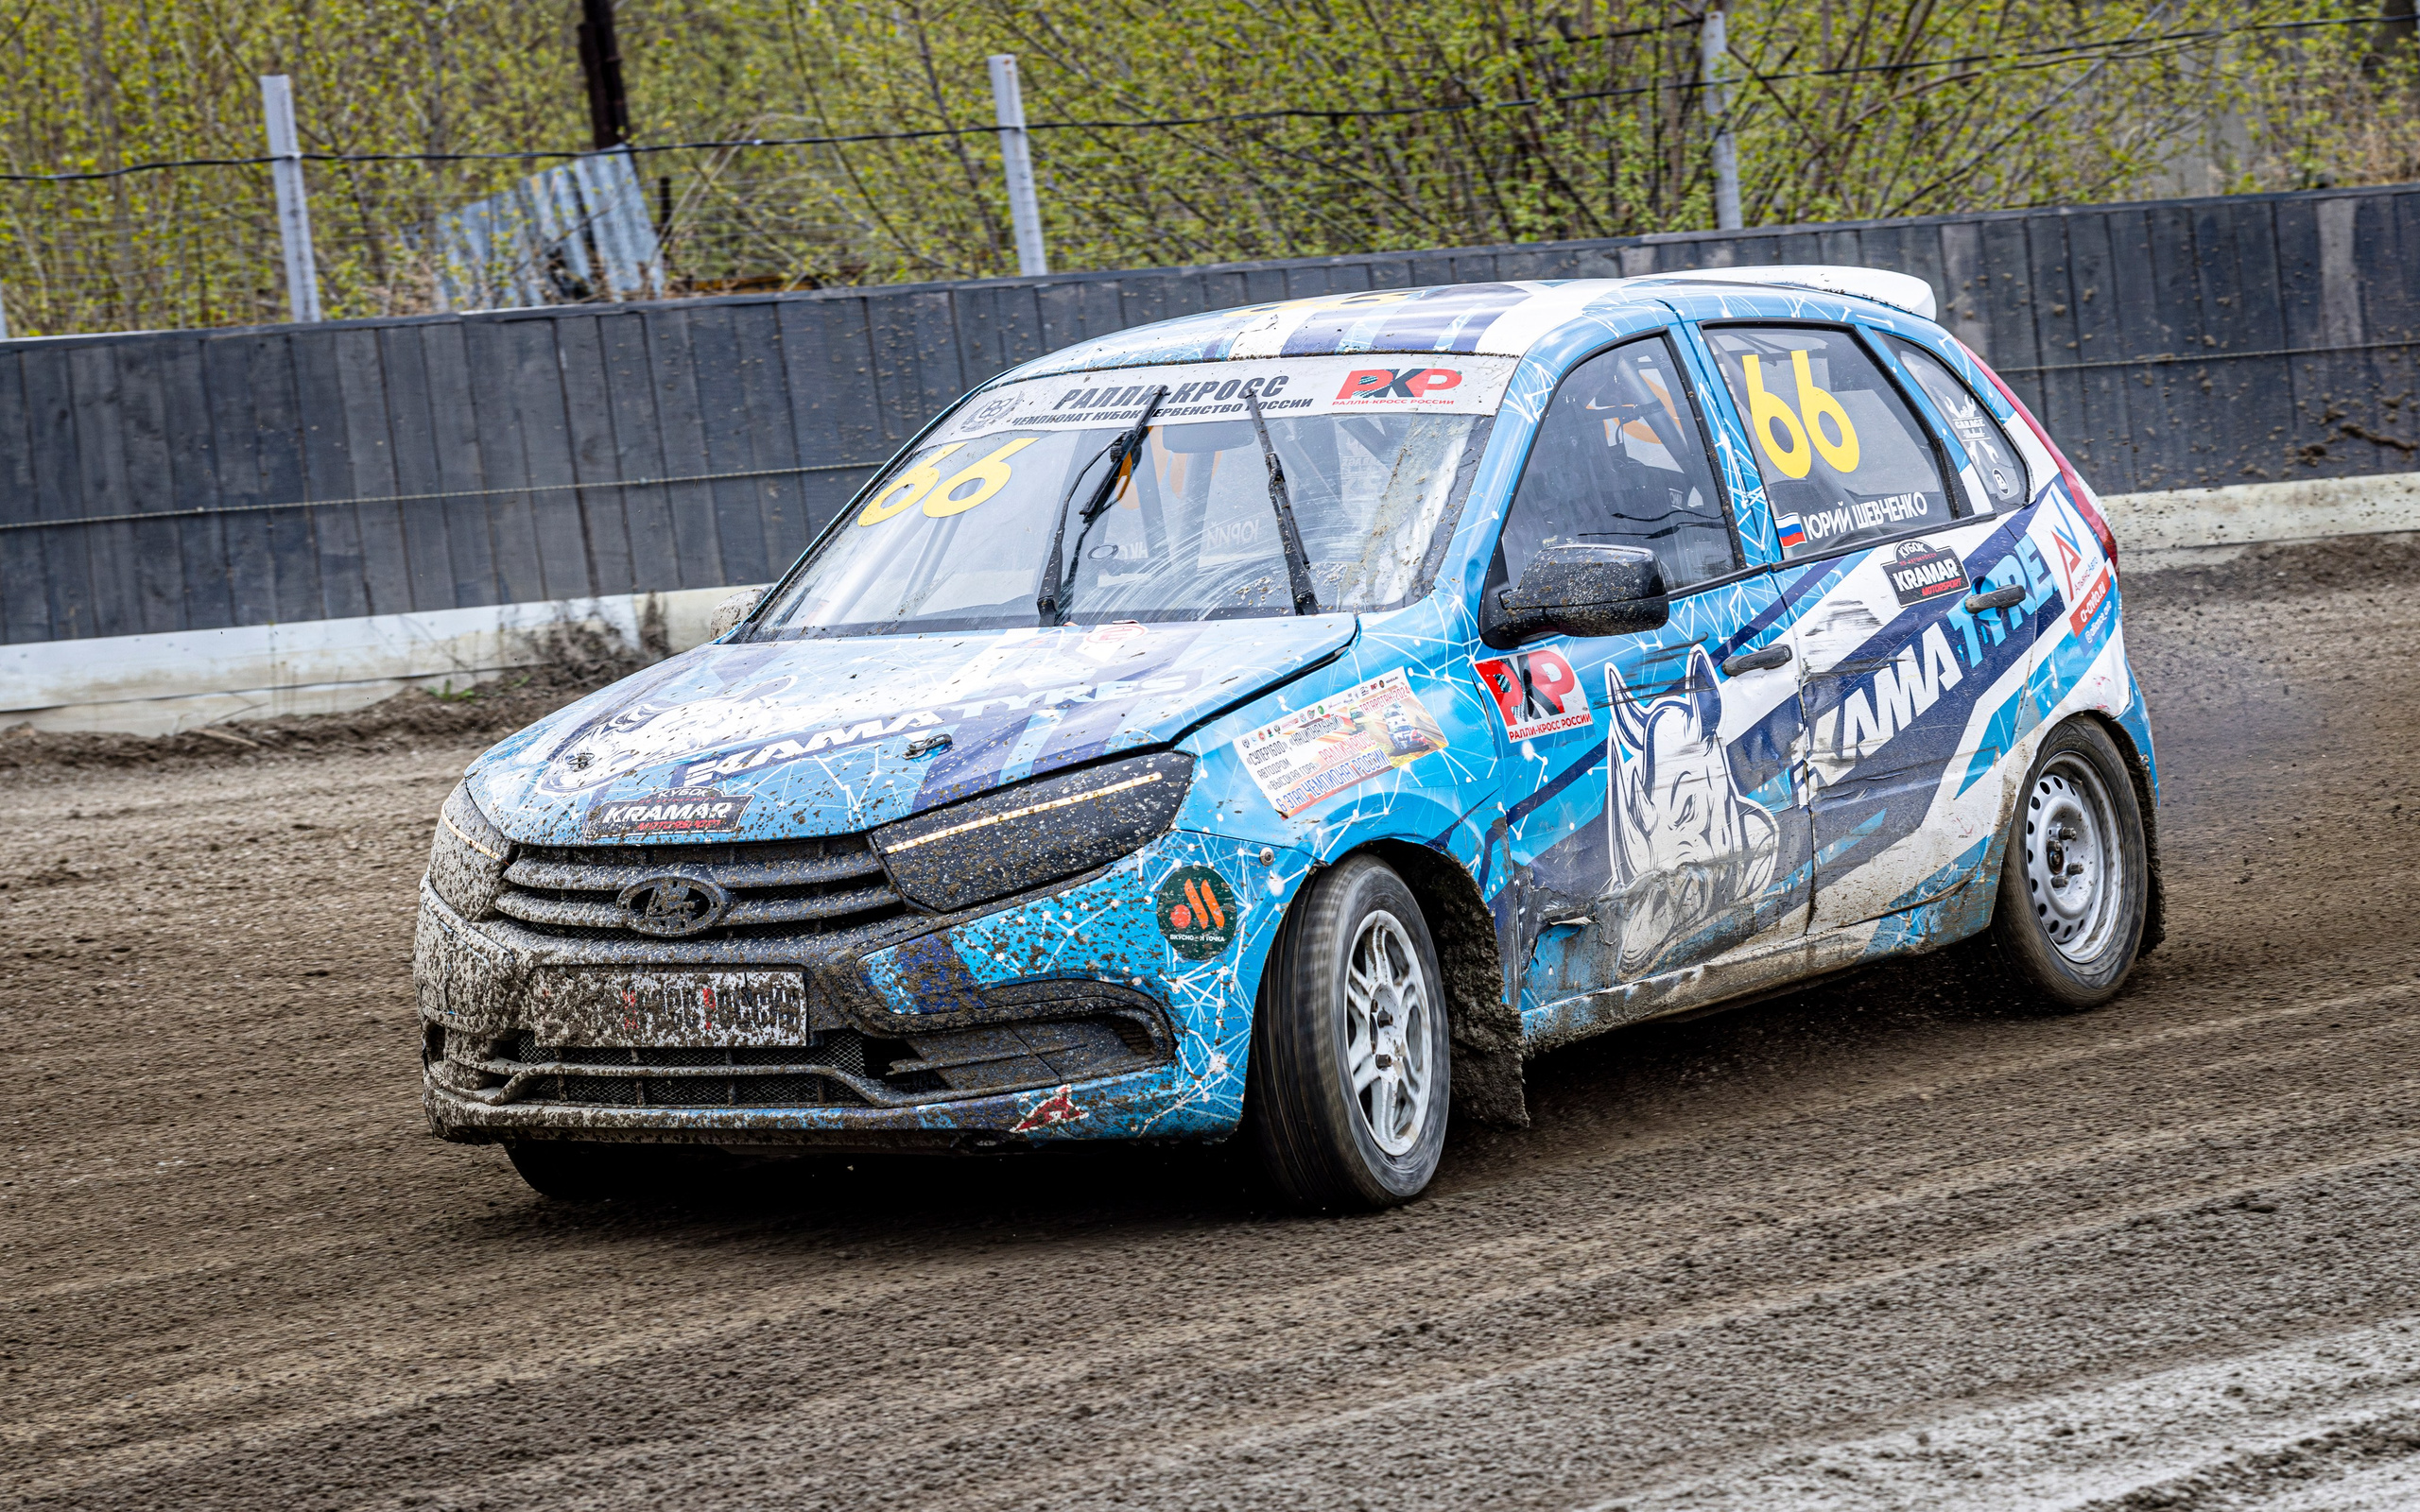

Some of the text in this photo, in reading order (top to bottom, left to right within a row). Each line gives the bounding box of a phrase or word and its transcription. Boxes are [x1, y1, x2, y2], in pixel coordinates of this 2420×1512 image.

[1011, 412, 1095, 426] ЧЕМПИОНАТ
[1092, 409, 1143, 421] КУБОК
[1244, 398, 1314, 412] ОССИИ
[1741, 349, 1860, 479] 66
[857, 437, 1040, 527] 66
[1802, 491, 1928, 541] ЮРИЙ ШЕВЧЕНКО
[1898, 542, 1928, 558] КУБОК
[1893, 558, 1961, 593] KRAMAR
[1921, 577, 1962, 596] MOTORSPORT
[1509, 713, 1592, 740] РАЛЛИ-КРОСС РОССИИ
[1789, 621, 1963, 810] KAMA
[683, 675, 1187, 787] KAMA TYRES
[1318, 730, 1377, 765] РАЛЛИ-КРОСС
[1256, 758, 1292, 781] АВТОДРОМ
[1267, 761, 1322, 791] «ВЫСОКАЯ ГОРА»
[1275, 748, 1392, 813] 6 ЭТАП ЧЕМПИОНАТ РОССИИ
[657, 787, 710, 799] КУБОК
[602, 802, 733, 824] KRAMAR
[637, 819, 722, 832] MOTORSPORT
